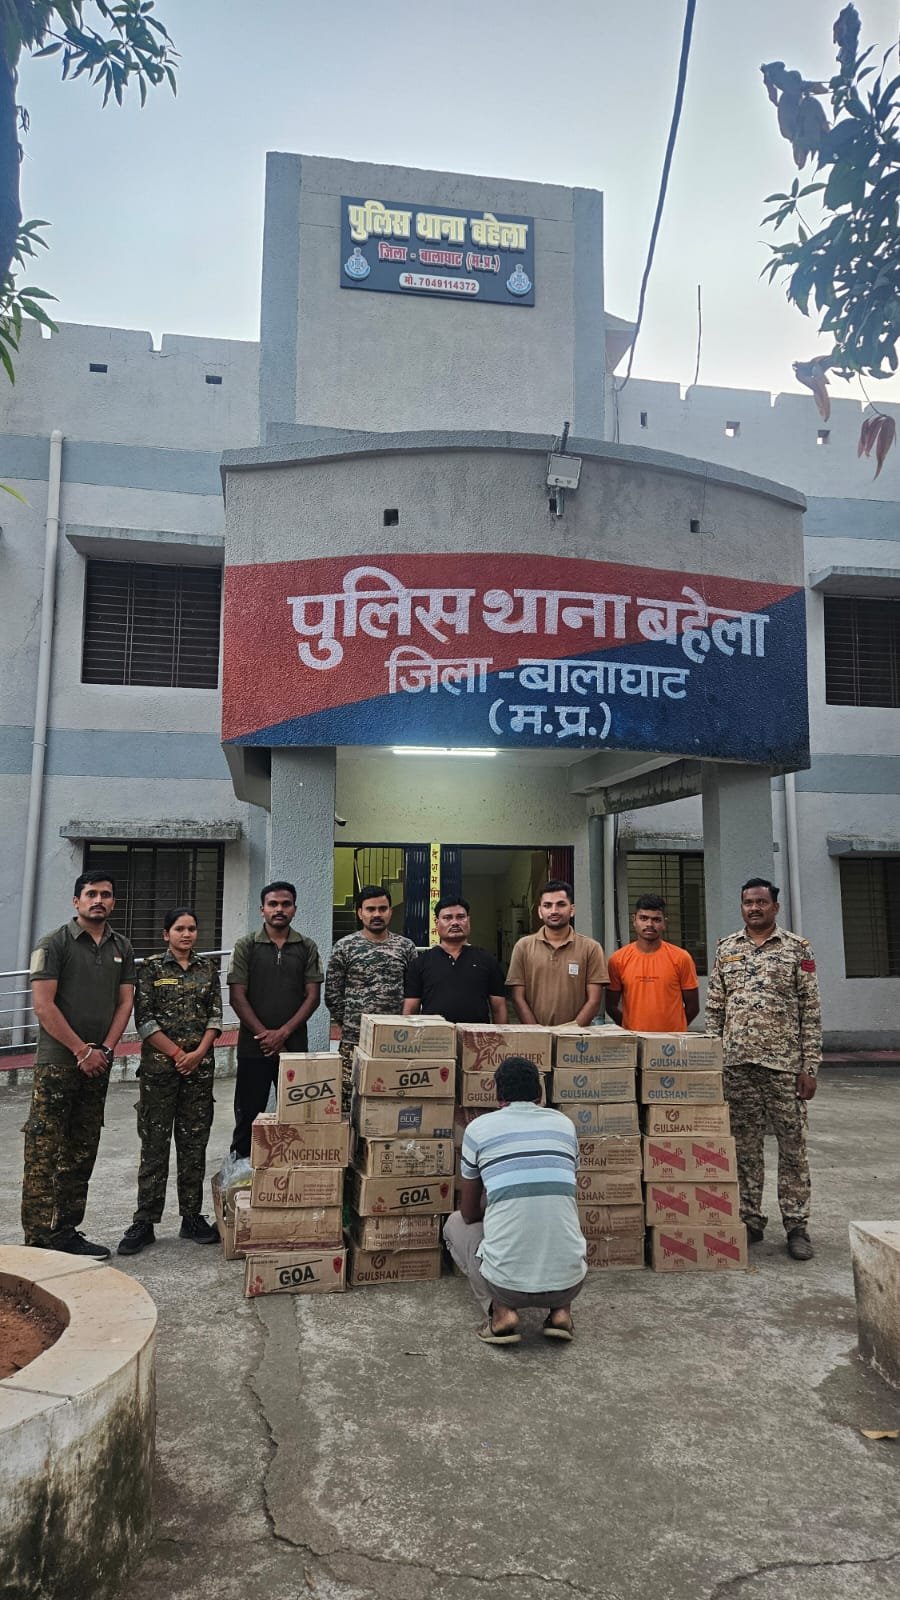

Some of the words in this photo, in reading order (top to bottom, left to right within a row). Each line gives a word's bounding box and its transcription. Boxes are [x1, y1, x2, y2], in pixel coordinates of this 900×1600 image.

[348, 200, 412, 241] पुलिस
[416, 212, 467, 243] थाना
[470, 212, 528, 249] बहेला
[378, 241, 407, 261] जिला
[419, 249, 463, 267] बालाघाट
[419, 277, 477, 291] 7049114372
[287, 566, 476, 670] पुलिस
[482, 587, 631, 639] थाना
[636, 586, 769, 663] बहेला
[384, 645, 493, 696] जिला
[518, 658, 690, 699] बालाघाट
[379, 1043, 421, 1054] GULSHAN
[563, 1054, 600, 1063] GULSHAN
[649, 1058, 688, 1067] GULSHAN
[399, 1071, 430, 1086] GOA
[288, 1082, 334, 1102] GOA
[467, 1092, 497, 1102] GULSH
[560, 1090, 600, 1098] GULSHAN
[648, 1090, 688, 1099] GULSHAN
[653, 1124, 693, 1133] GULSHAN
[280, 1147, 342, 1164] KINGFISHER
[258, 1191, 302, 1203] GULSHAN
[400, 1188, 430, 1204] GOA
[576, 1191, 606, 1201] LSHAN
[279, 1266, 315, 1286] GOA
[357, 1270, 399, 1282] GULSHAN
